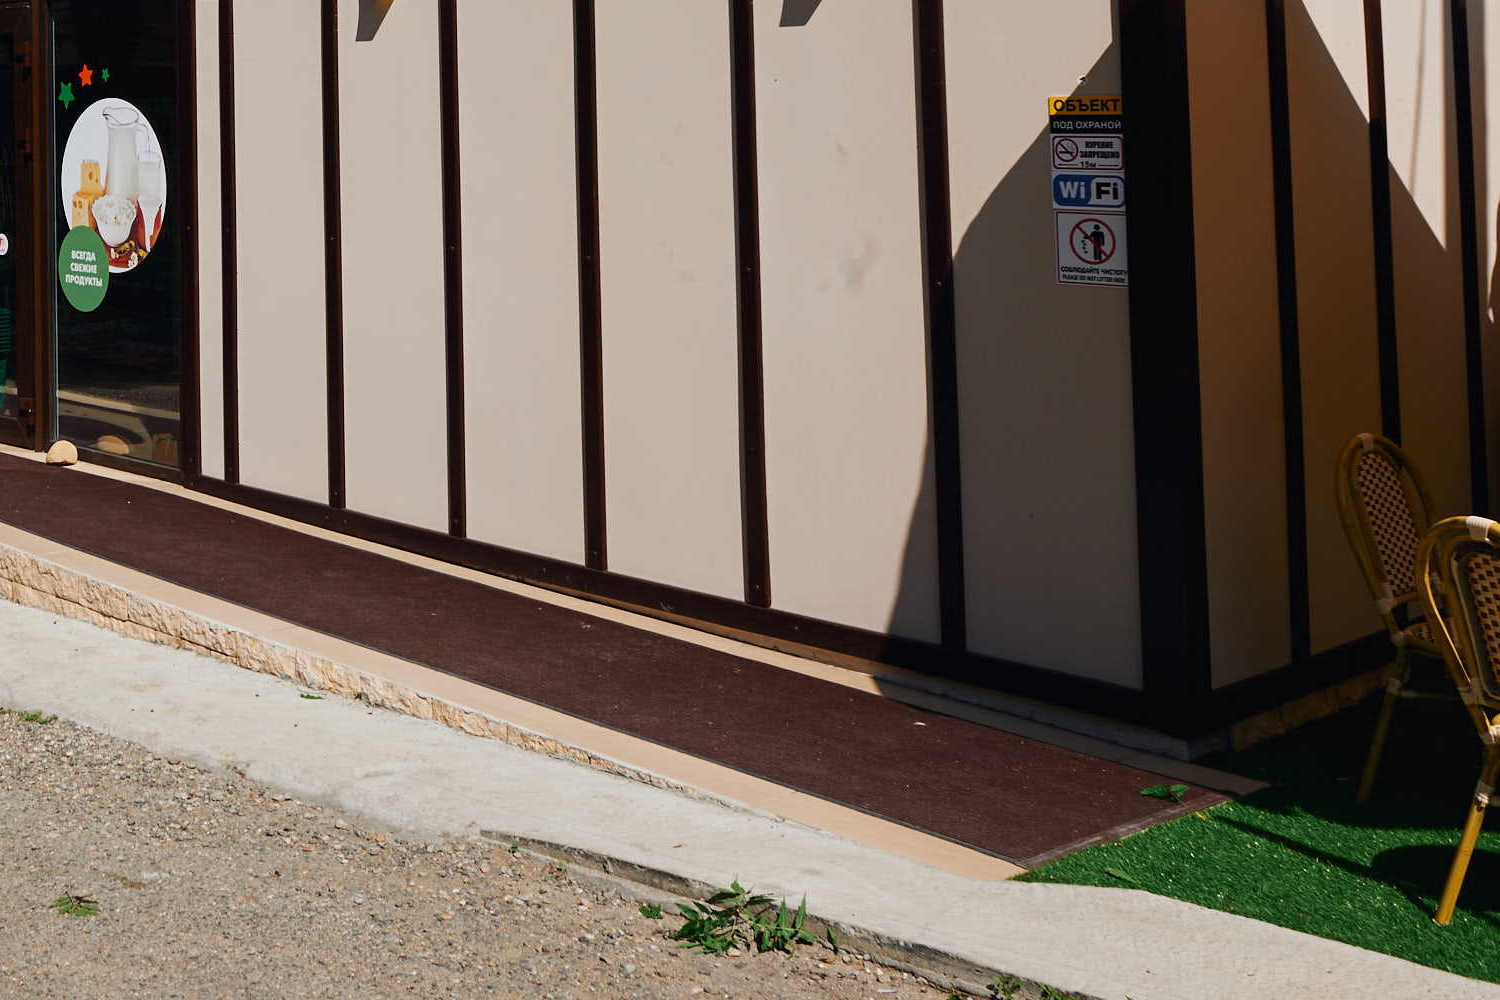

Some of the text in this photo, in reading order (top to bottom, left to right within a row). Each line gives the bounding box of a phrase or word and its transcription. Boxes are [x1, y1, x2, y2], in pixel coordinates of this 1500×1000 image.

[1054, 99, 1120, 112] ОБЪЕКТ
[1053, 120, 1122, 130] ПОД ОХРАНОЙ
[1085, 141, 1114, 149] КУРЕНИЕ
[1080, 151, 1120, 159] ЗАПРЕЩЕНО
[1060, 181, 1119, 200] Wi Fi
[71, 250, 97, 262] ВСЕГДА
[70, 262, 98, 274] СВЕЖИЕ
[1060, 266, 1100, 274] СОБЛЮДАЙТЕ
[65, 274, 103, 287] ПРОДУКТЫ
